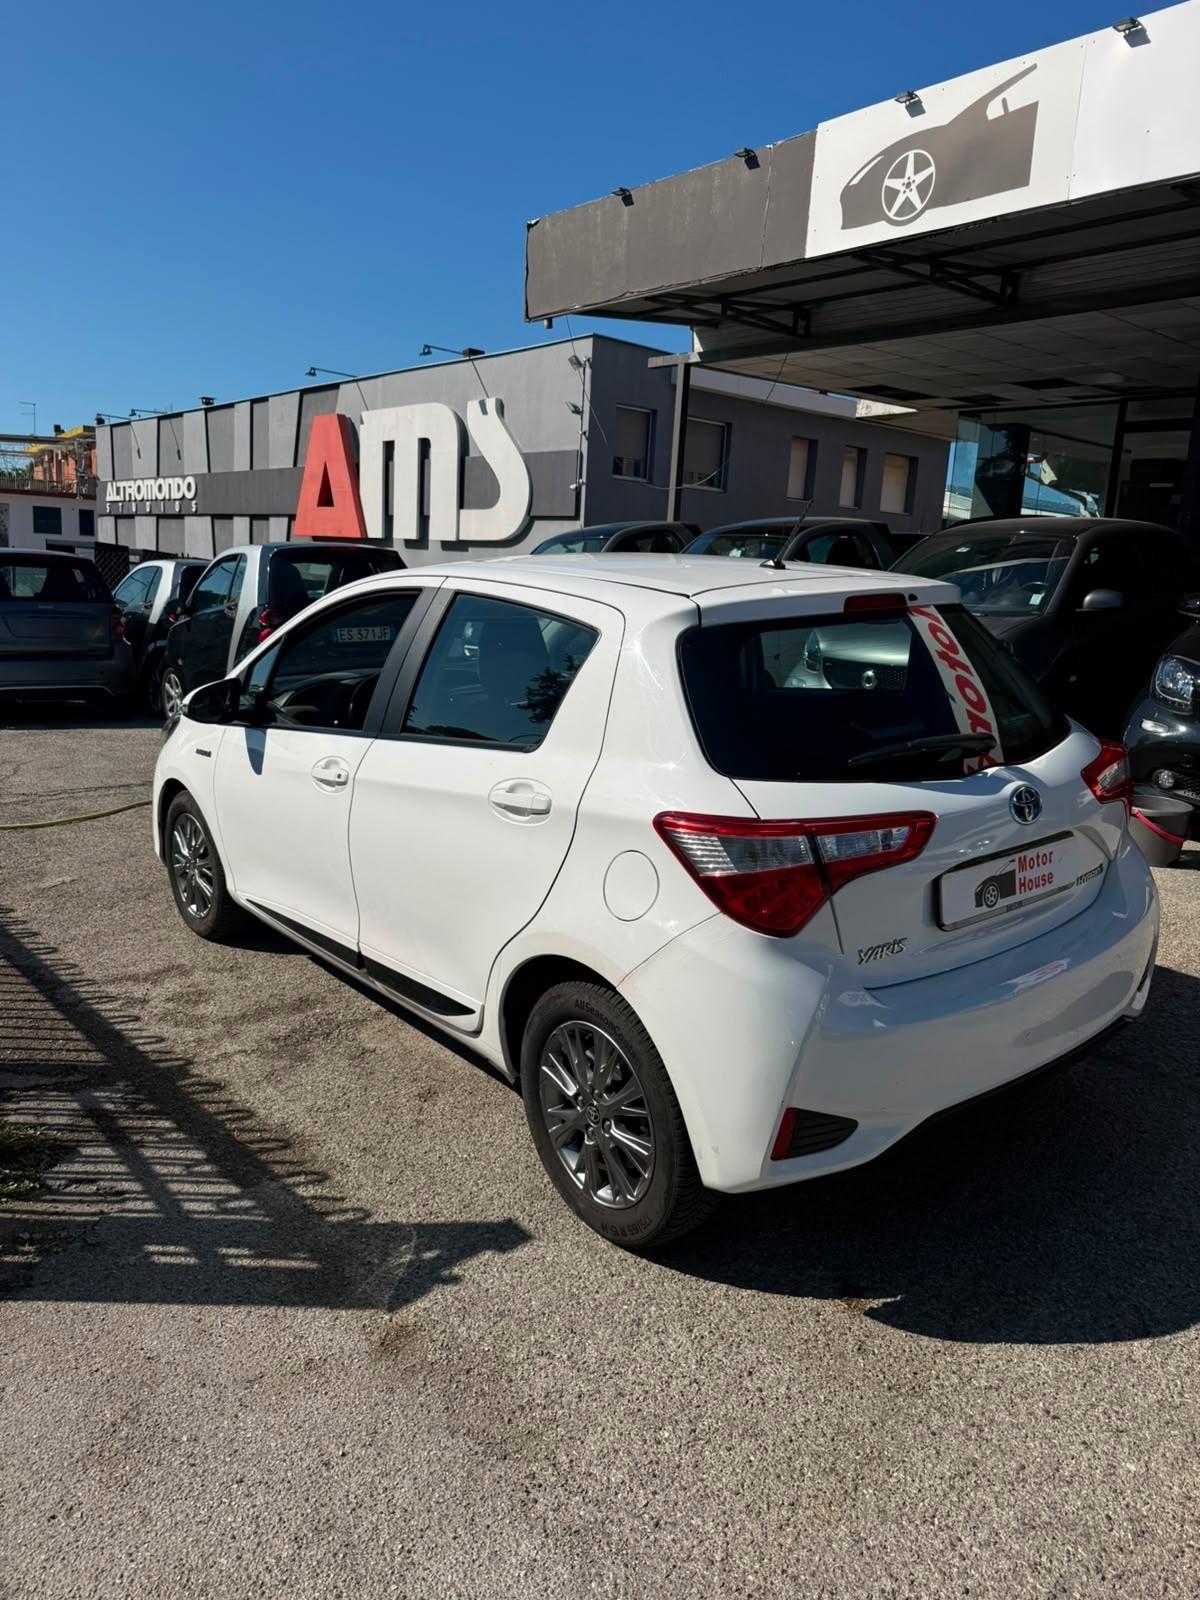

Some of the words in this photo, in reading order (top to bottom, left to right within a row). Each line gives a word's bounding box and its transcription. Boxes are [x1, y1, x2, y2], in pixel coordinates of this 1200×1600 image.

[105, 476, 196, 502] ALTROMONDO
[105, 500, 197, 513] STUDIOS
[1018, 851, 1054, 874] Motor
[1018, 872, 1054, 894] House
[857, 937, 908, 965] YARIS
